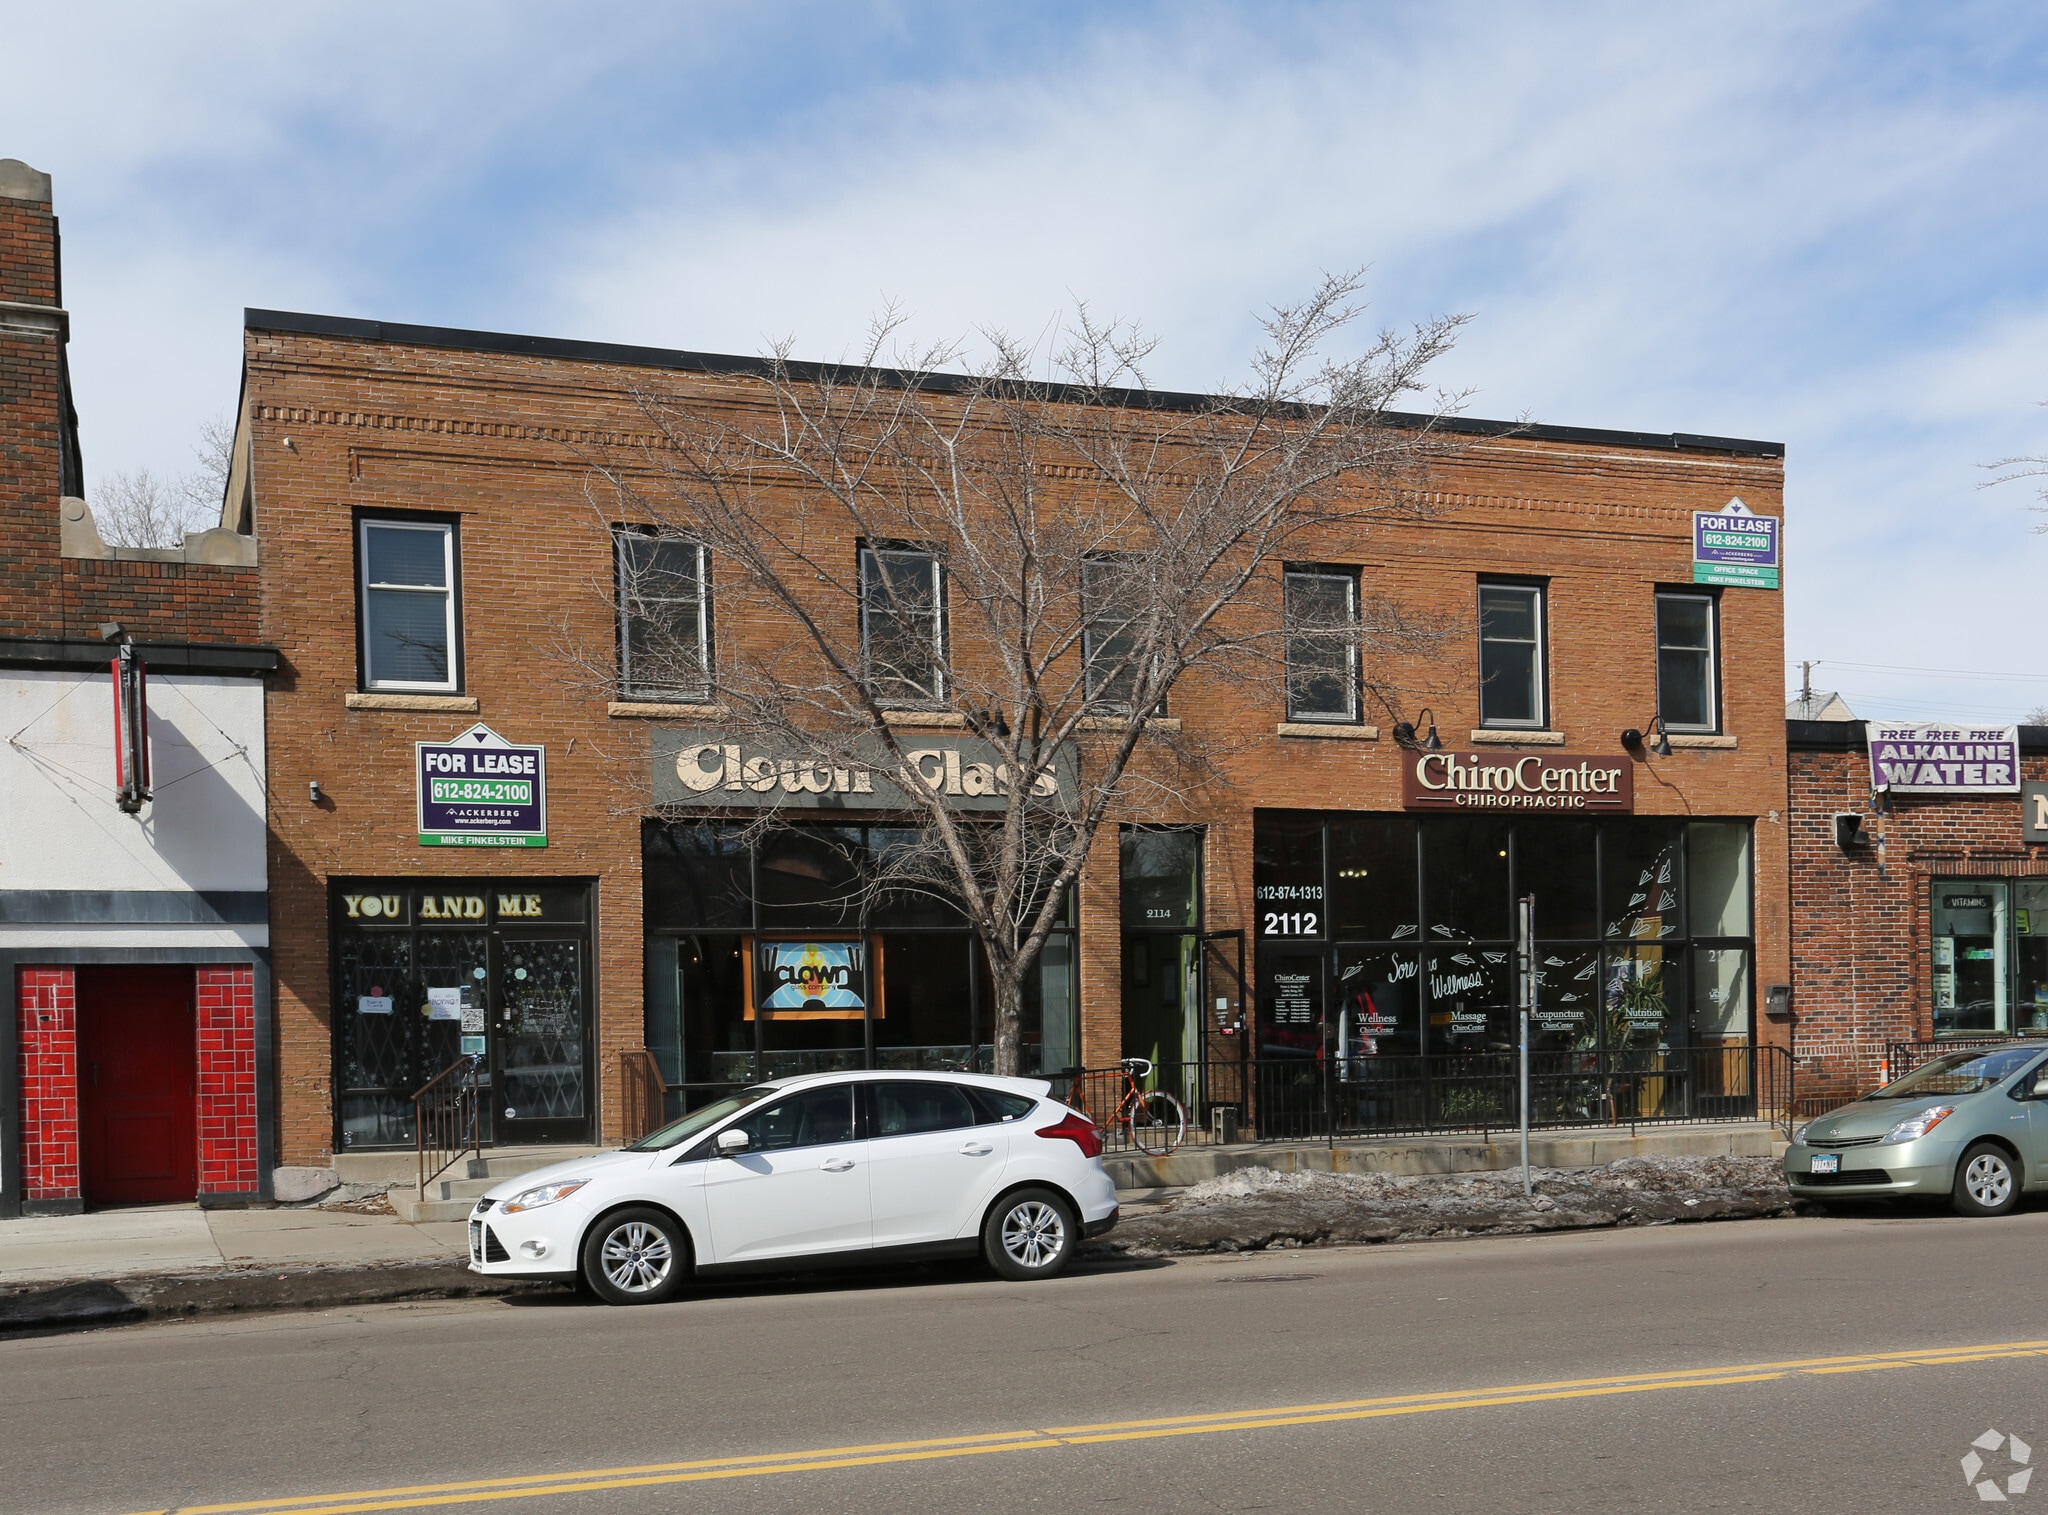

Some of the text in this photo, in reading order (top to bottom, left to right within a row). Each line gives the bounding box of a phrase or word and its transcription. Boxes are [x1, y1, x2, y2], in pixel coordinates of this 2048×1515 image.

[1700, 517, 1772, 533] FOR LEASE
[1705, 534, 1767, 548] 612-824-2100
[1880, 730, 2005, 741] FREE FREE FREE
[1878, 744, 2011, 761] ALKALINE
[425, 753, 536, 774] FOR LEASE
[676, 743, 875, 794] Clown
[1416, 753, 1622, 794] ChiroCenter
[1878, 762, 2013, 785] WATER
[433, 782, 529, 801] 612-824-2100
[1455, 793, 1586, 808] CHIROPRACTIC
[459, 809, 520, 817] ACKERBERG
[455, 817, 511, 826] www.ackerberg.com
[440, 836, 526, 845] MIKE FINKELSTEIN
[1257, 885, 1323, 900] 612-874-1313
[342, 894, 543, 919] YOU AND ME
[1951, 897, 1987, 907] VITAMINS
[1146, 909, 1171, 918] 2114
[1264, 912, 1318, 935] 2112
[1429, 971, 1484, 1000] Wellness
[1357, 1012, 1397, 1023] Wellness
[1451, 1011, 1487, 1024] Massage
[1625, 1007, 1662, 1017] Nutrition
